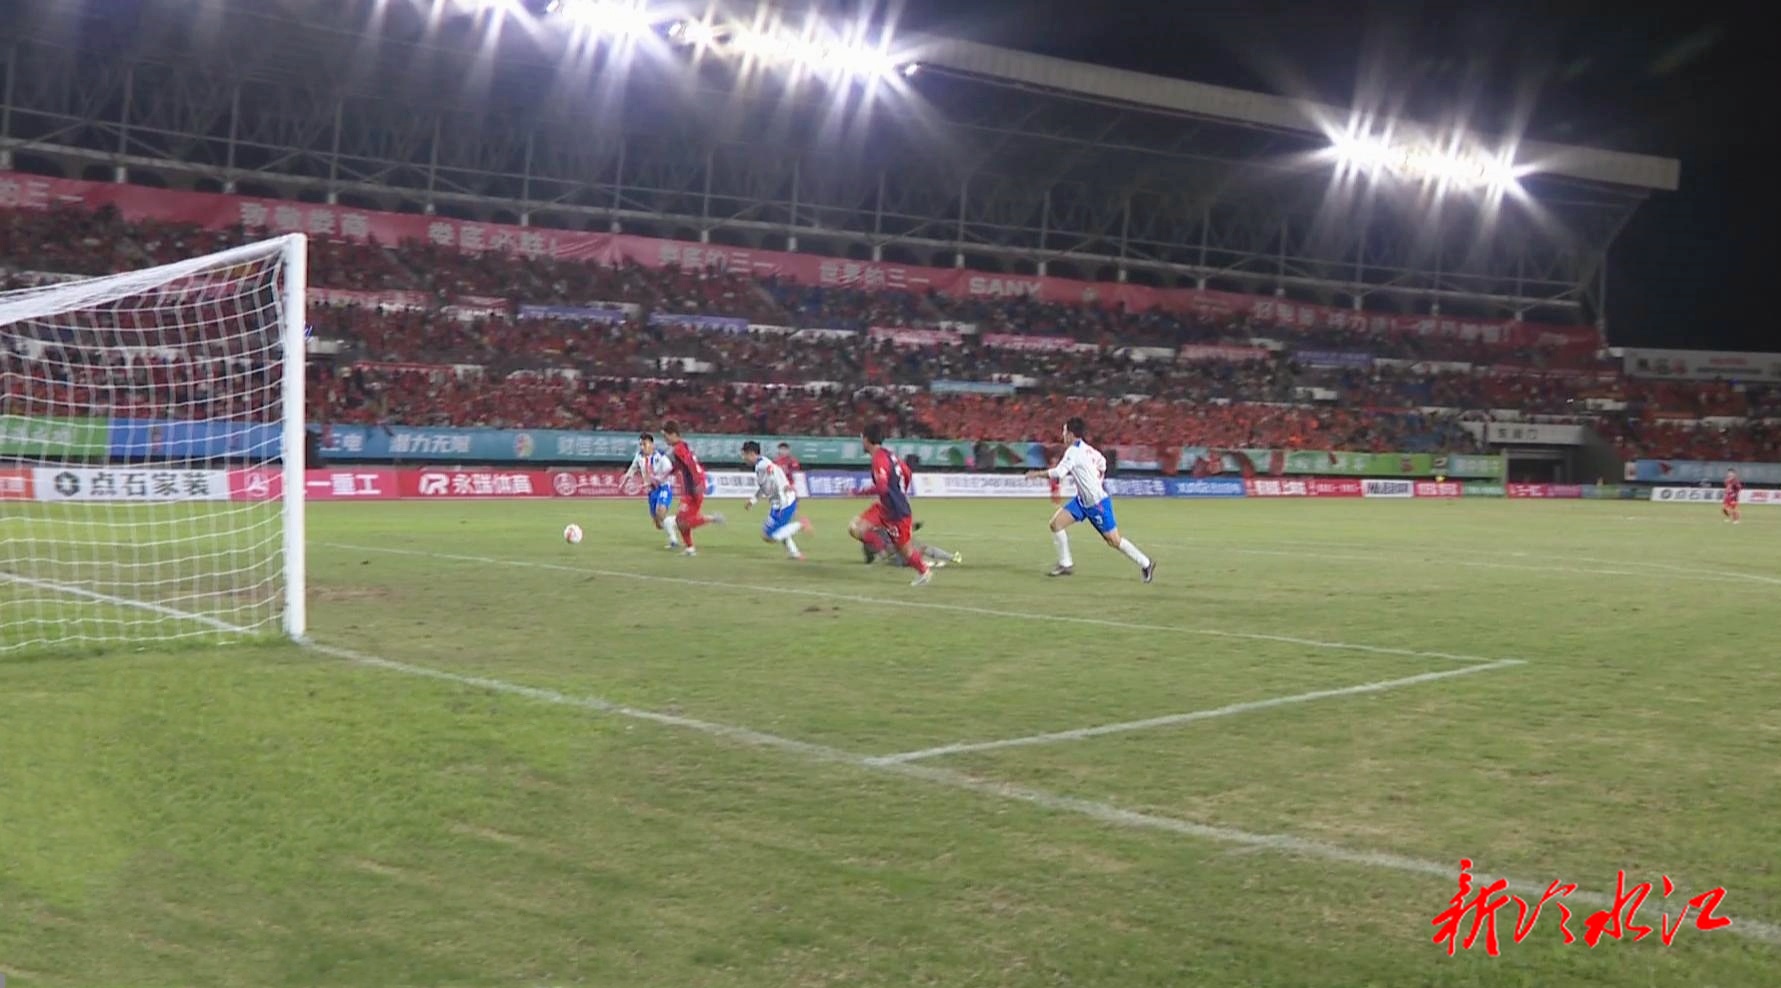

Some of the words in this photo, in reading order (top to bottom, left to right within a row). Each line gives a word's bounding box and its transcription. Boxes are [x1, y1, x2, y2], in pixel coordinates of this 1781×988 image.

[969, 276, 1041, 296] SANY
[91, 471, 210, 497] 点石家装
